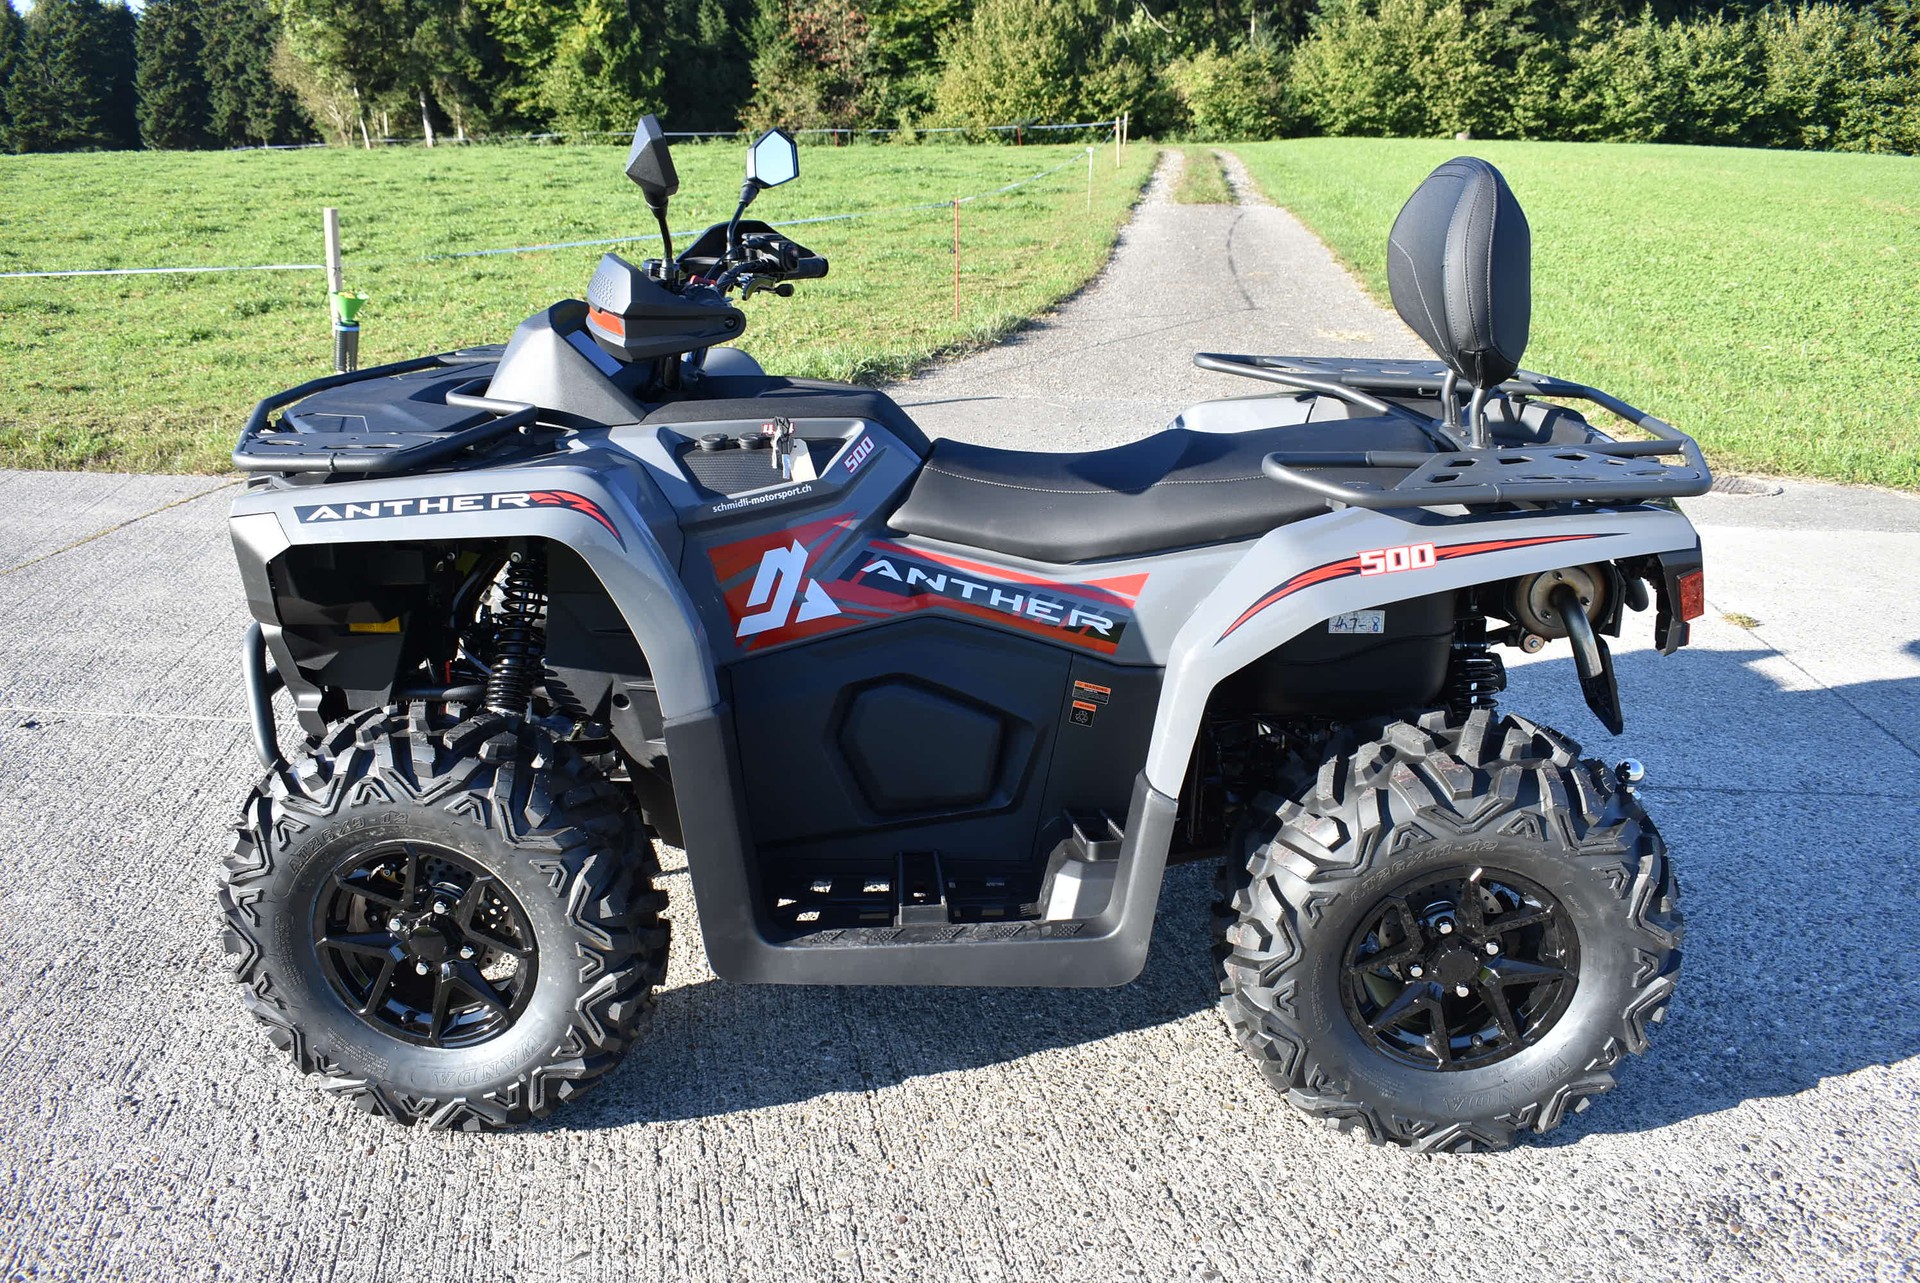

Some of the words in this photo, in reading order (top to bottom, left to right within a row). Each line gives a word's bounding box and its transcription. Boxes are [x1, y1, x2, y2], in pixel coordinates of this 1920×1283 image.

[843, 435, 875, 473] 500
[305, 493, 531, 521] ANTHER
[712, 484, 812, 512] schmidli-motorsport.ch
[1358, 542, 1437, 576] 500
[861, 559, 1113, 636] ANTHER
[432, 1035, 541, 1088] WANDA
